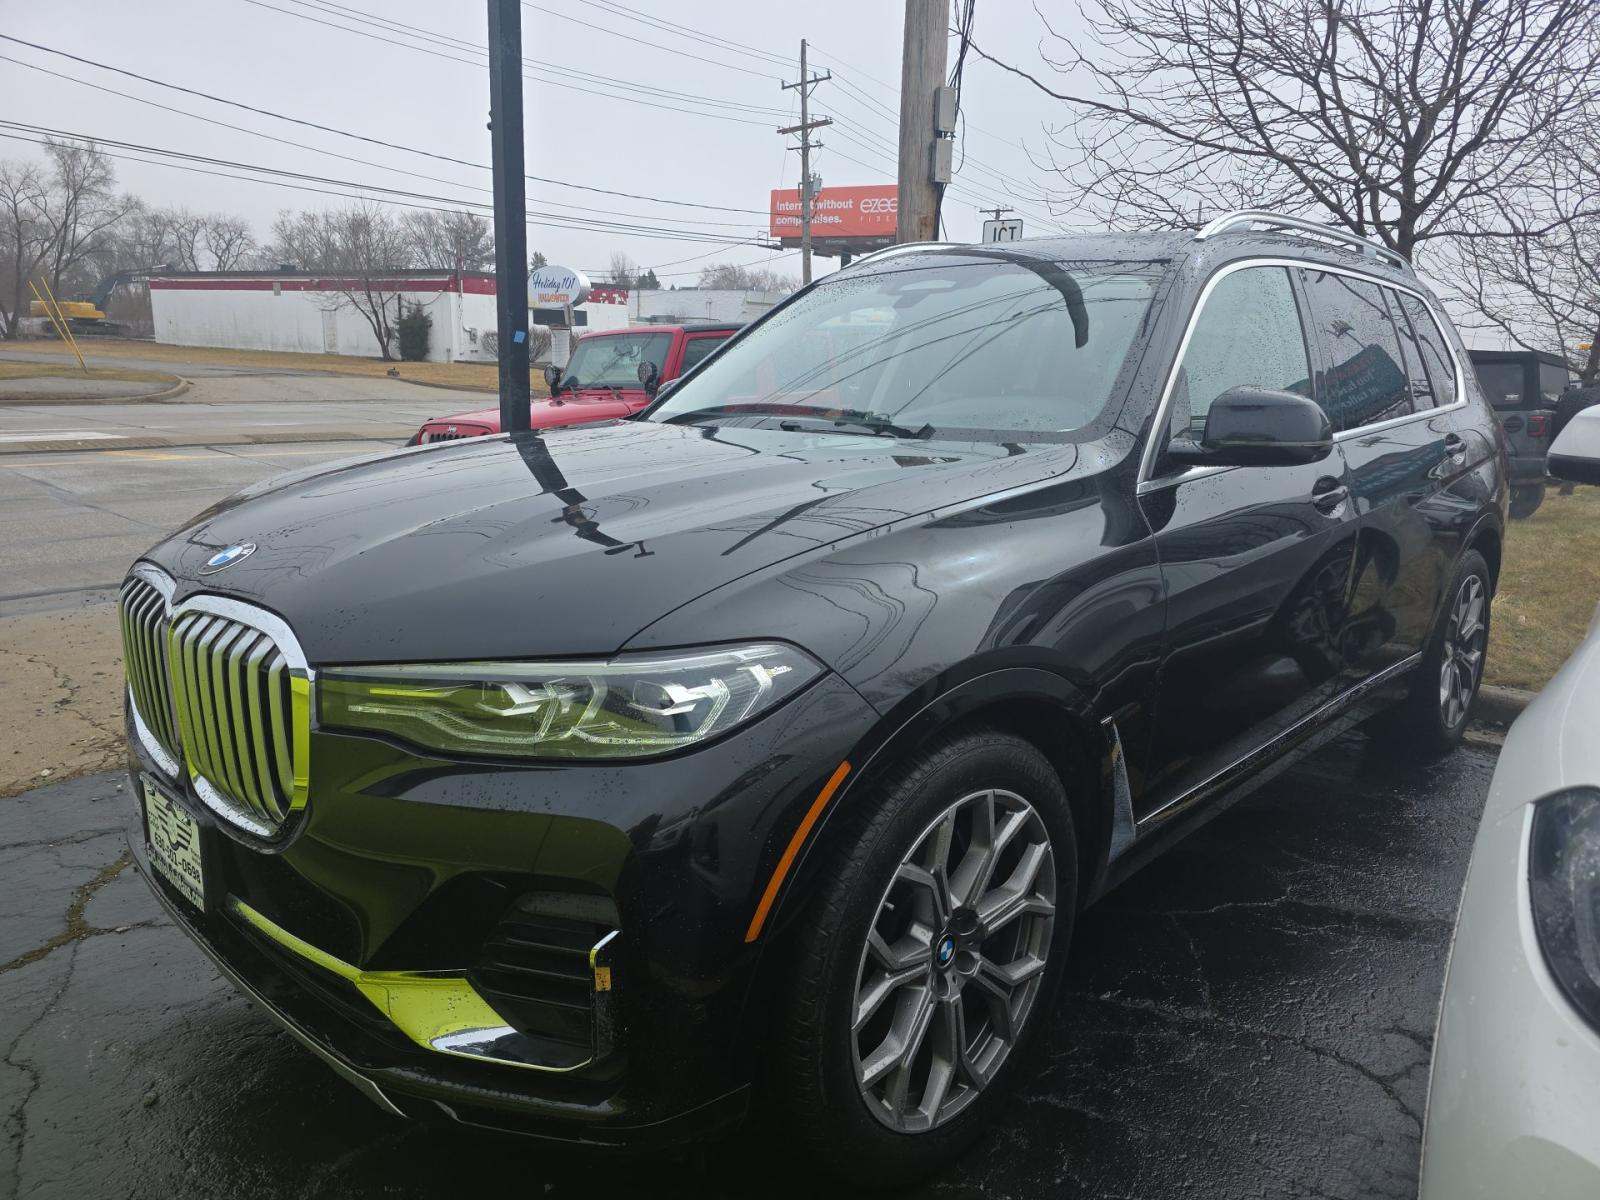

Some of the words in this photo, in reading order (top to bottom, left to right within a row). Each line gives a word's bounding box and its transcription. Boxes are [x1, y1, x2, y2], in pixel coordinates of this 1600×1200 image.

[816, 199, 853, 210] without
[776, 214, 842, 225] compmises.
[532, 271, 561, 293] Holiday
[561, 276, 576, 290] 101
